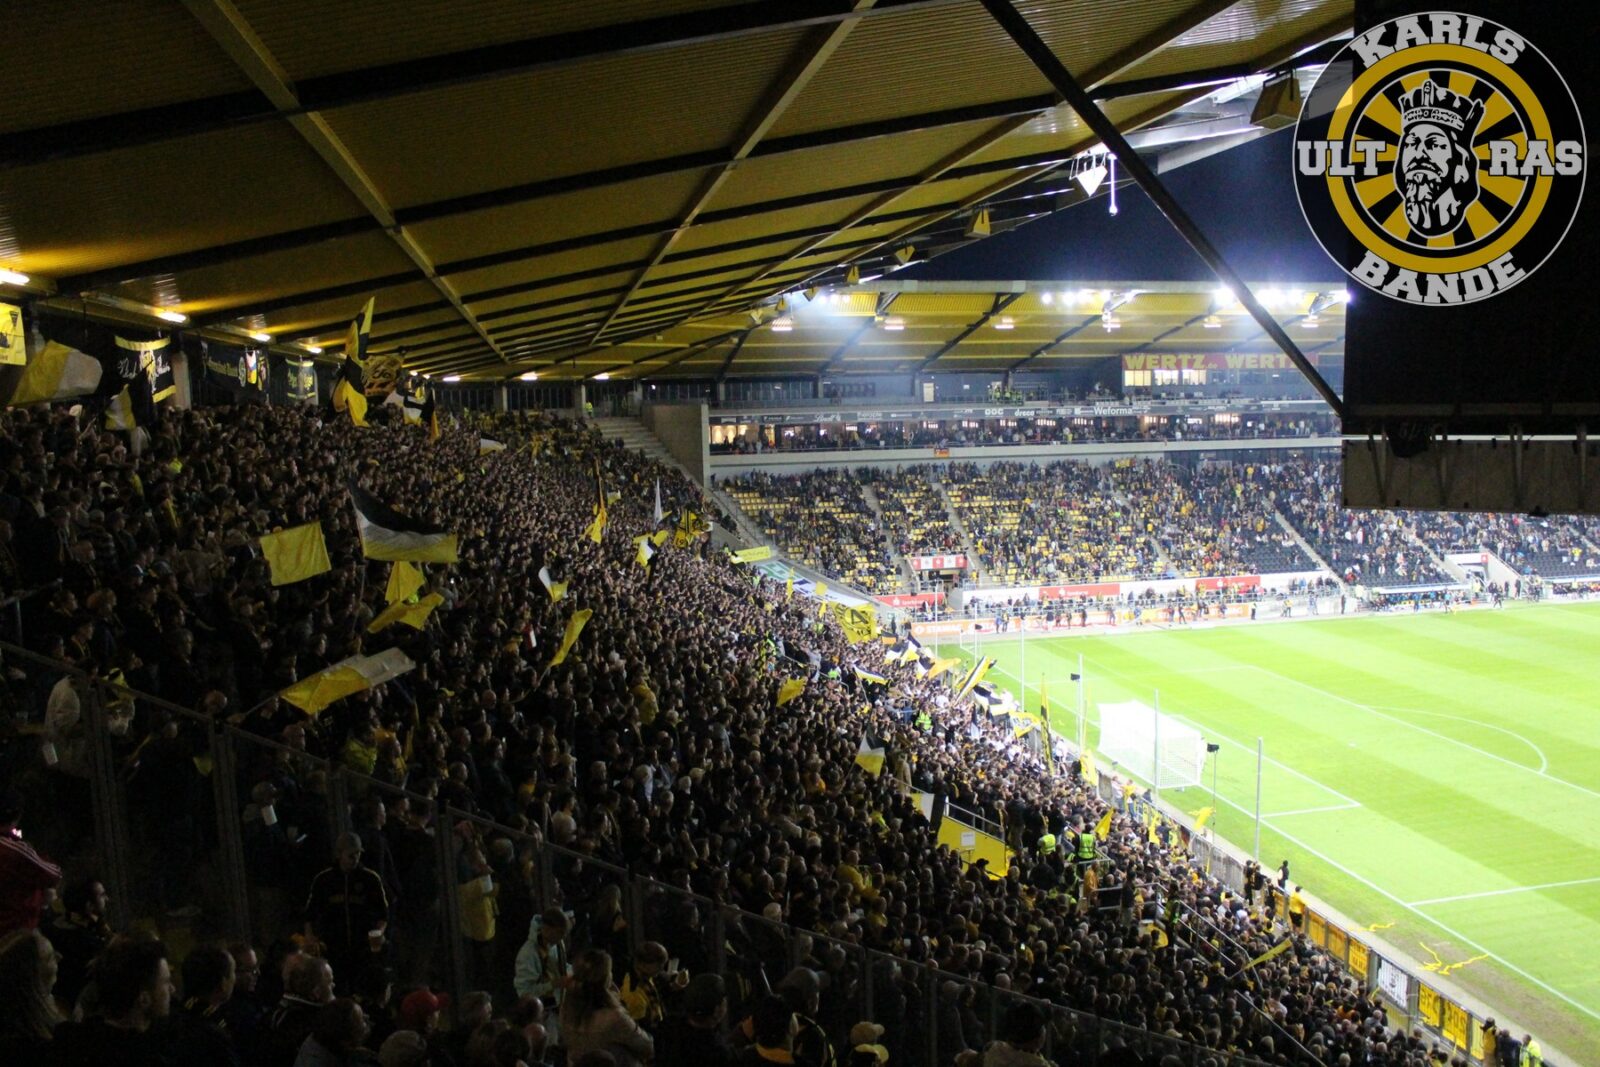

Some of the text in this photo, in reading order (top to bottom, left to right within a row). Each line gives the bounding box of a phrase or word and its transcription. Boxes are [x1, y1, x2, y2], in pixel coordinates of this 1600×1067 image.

[1124, 354, 1206, 369] WERTZ
[1225, 354, 1298, 369] WERT
[1094, 406, 1132, 416] Weforma
